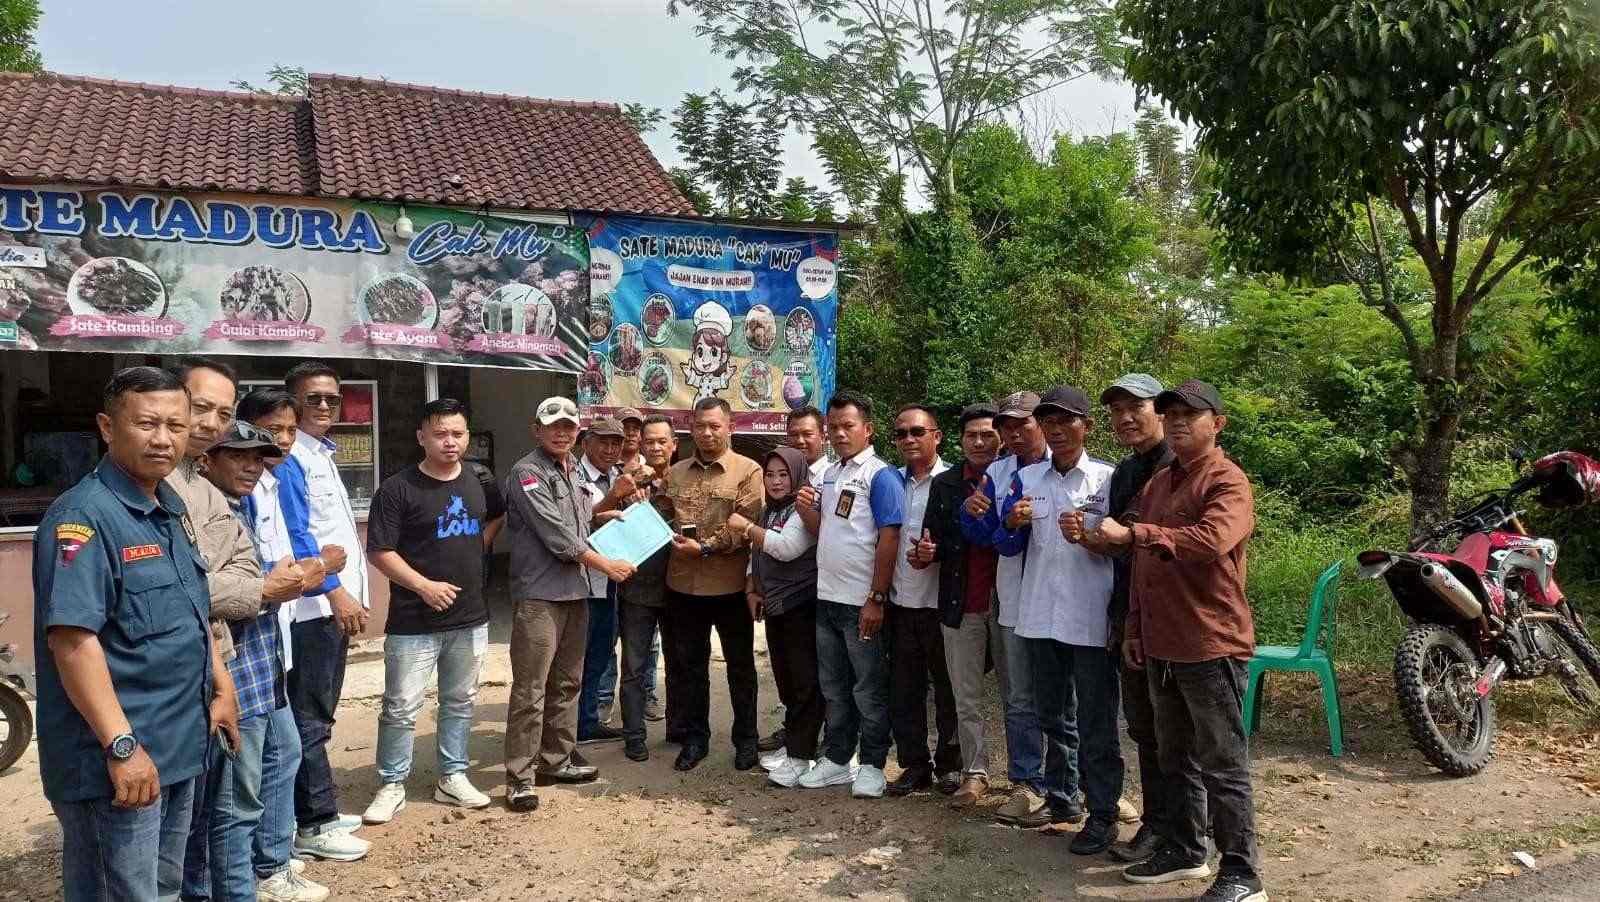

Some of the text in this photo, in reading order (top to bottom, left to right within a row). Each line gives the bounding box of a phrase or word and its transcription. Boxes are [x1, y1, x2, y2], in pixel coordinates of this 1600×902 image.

[98, 192, 388, 254] MADURA
[407, 221, 487, 265] Cak
[620, 236, 659, 259] SATE
[663, 236, 722, 259] MADURA
[670, 272, 691, 282] JAJAN
[692, 275, 709, 285] ENAK
[711, 277, 724, 286] DAN
[70, 318, 174, 336] Sate Kambing
[259, 325, 316, 339] Kambing
[396, 331, 438, 346] Ayam
